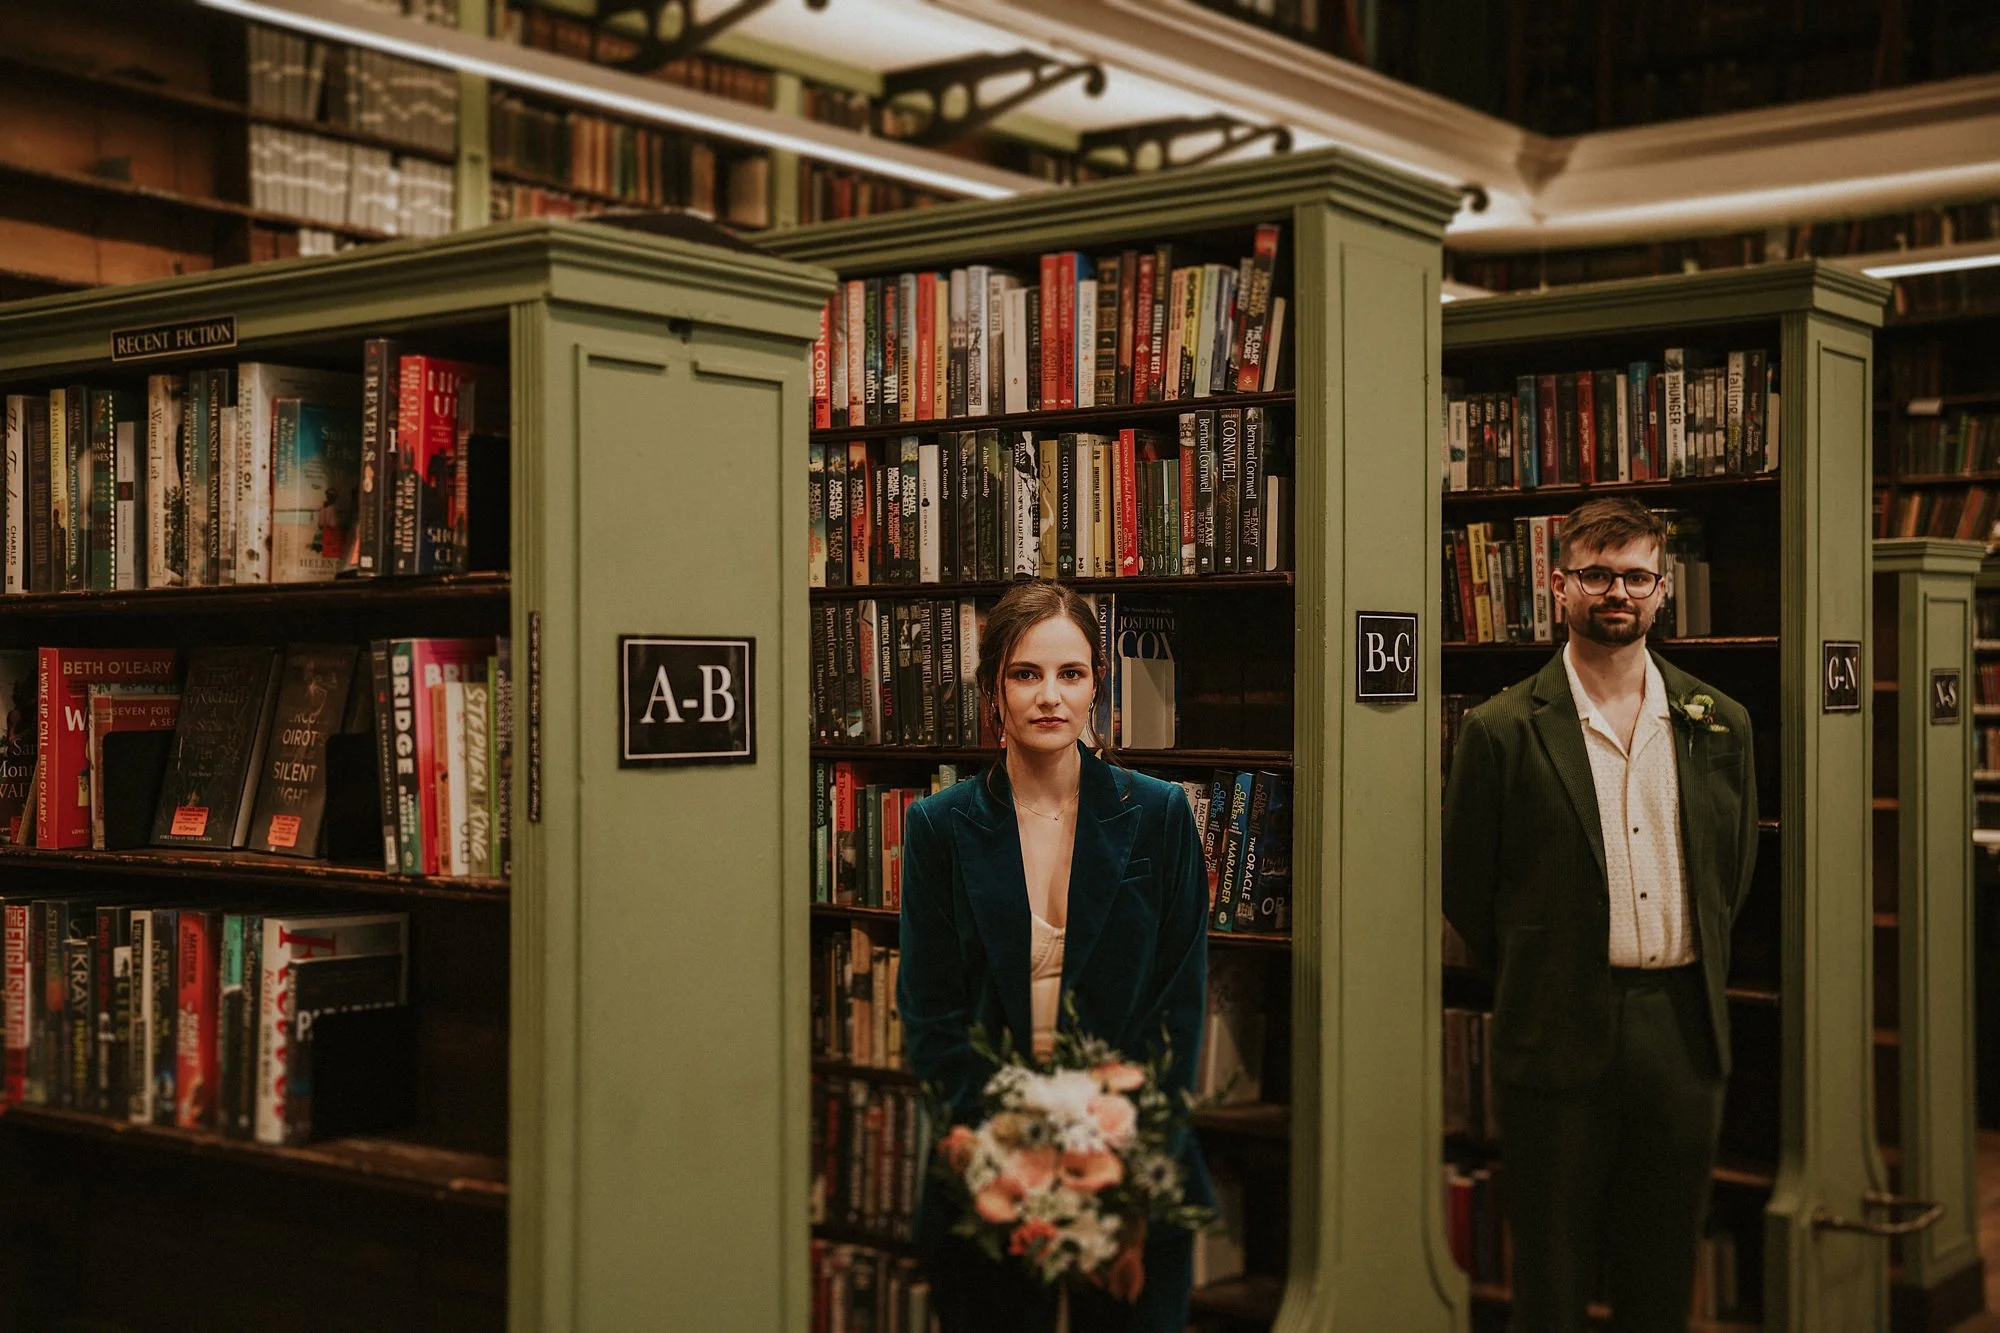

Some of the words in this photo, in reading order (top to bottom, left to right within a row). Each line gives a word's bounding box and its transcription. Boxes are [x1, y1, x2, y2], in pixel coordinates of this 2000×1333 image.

[885, 287, 897, 328] Harlan
[1152, 304, 1163, 335] CENTRAL
[117, 332, 170, 354] RECENT
[176, 322, 231, 347] FICTION
[1152, 336, 1161, 354] PARK
[1243, 329, 1253, 360] HOURS
[1253, 325, 1263, 340] THE
[885, 331, 897, 372] Coben
[901, 346, 909, 386] JONATHAN
[1150, 356, 1160, 375] WEST
[1250, 342, 1260, 365] DARK
[815, 349, 826, 397] COBEN
[850, 347, 861, 392] COBEN
[865, 369, 875, 404] MATCH
[210, 379, 218, 416] NORTH
[883, 374, 898, 404] WIN
[901, 388, 909, 403] COE
[1669, 382, 1680, 425] HUNGER
[1728, 372, 1741, 414] falling
[150, 408, 162, 449] Winter
[210, 420, 218, 462] WOODS
[244, 421, 252, 467] CURSE
[1199, 418, 1210, 453] Bernard
[1246, 425, 1256, 459] Bernard
[1222, 420, 1236, 481] CORNWELL
[244, 472, 252, 491] OF
[941, 469, 949, 500] Connolly
[960, 468, 968, 500] Connolly
[1199, 455, 1210, 492] Cornwell
[1246, 461, 1256, 499] Cornwell
[210, 477, 218, 513] DANIEL
[222, 460, 233, 550] ANCESTRY
[888, 502, 893, 511] OF
[908, 477, 916, 515] MICHAEL
[210, 518, 218, 558] MASON
[1197, 512, 1205, 544] BEARER
[1205, 517, 1213, 547] FLAME
[1534, 525, 1543, 556] CRIME
[1535, 558, 1544, 589] SCENE
[826, 608, 836, 642] Bernard
[845, 608, 854, 641] Bernard
[880, 615, 889, 645] PATRICIA
[920, 608, 930, 642] PATRICIA
[941, 608, 951, 640] PATRICIA
[1119, 615, 1176, 632] JOSEPHINE
[827, 644, 838, 677] Cornwell
[846, 643, 855, 673] Cornwell
[1117, 630, 1176, 659] COX
[1366, 633, 1411, 673] B-G
[63, 661, 103, 675] BETH
[108, 661, 172, 675] O'LEARY
[882, 646, 890, 683] CORNWELL
[921, 644, 932, 684] CORNWELL
[942, 644, 953, 684] CORNWELL
[1829, 656, 1856, 690] G-N
[40, 672, 49, 718] WAKE-UP
[112, 707, 146, 716] SEVEN
[151, 706, 170, 715] FOR
[640, 664, 736, 724] A-B
[863, 679, 872, 724] AUTOPSY
[883, 688, 892, 717] LIVID
[392, 655, 413, 775] BRIDGE
[923, 696, 934, 732] QUANTUM
[40, 721, 49, 749] CALL
[464, 686, 487, 792] STEPHEN
[273, 761, 318, 782] SILENT
[816, 762, 824, 797] ROBERT
[39, 781, 47, 822] O'LEARY
[816, 799, 824, 825] CRAIS
[1210, 782, 1220, 818] CUSSLER
[1217, 790, 1227, 813] CLIVE
[1231, 783, 1241, 820] CUSSLER
[1238, 791, 1246, 815] CLIVE
[469, 805, 488, 862] KING
[1205, 832, 1215, 860] GREY
[1248, 837, 1256, 853] THE
[1220, 840, 1237, 904] MARAUDER
[1241, 854, 1256, 901] ORACLE
[7, 909, 24, 927] THE
[6, 928, 25, 1049] ENGLISHMAN
[72, 952, 89, 1013] KRAY
